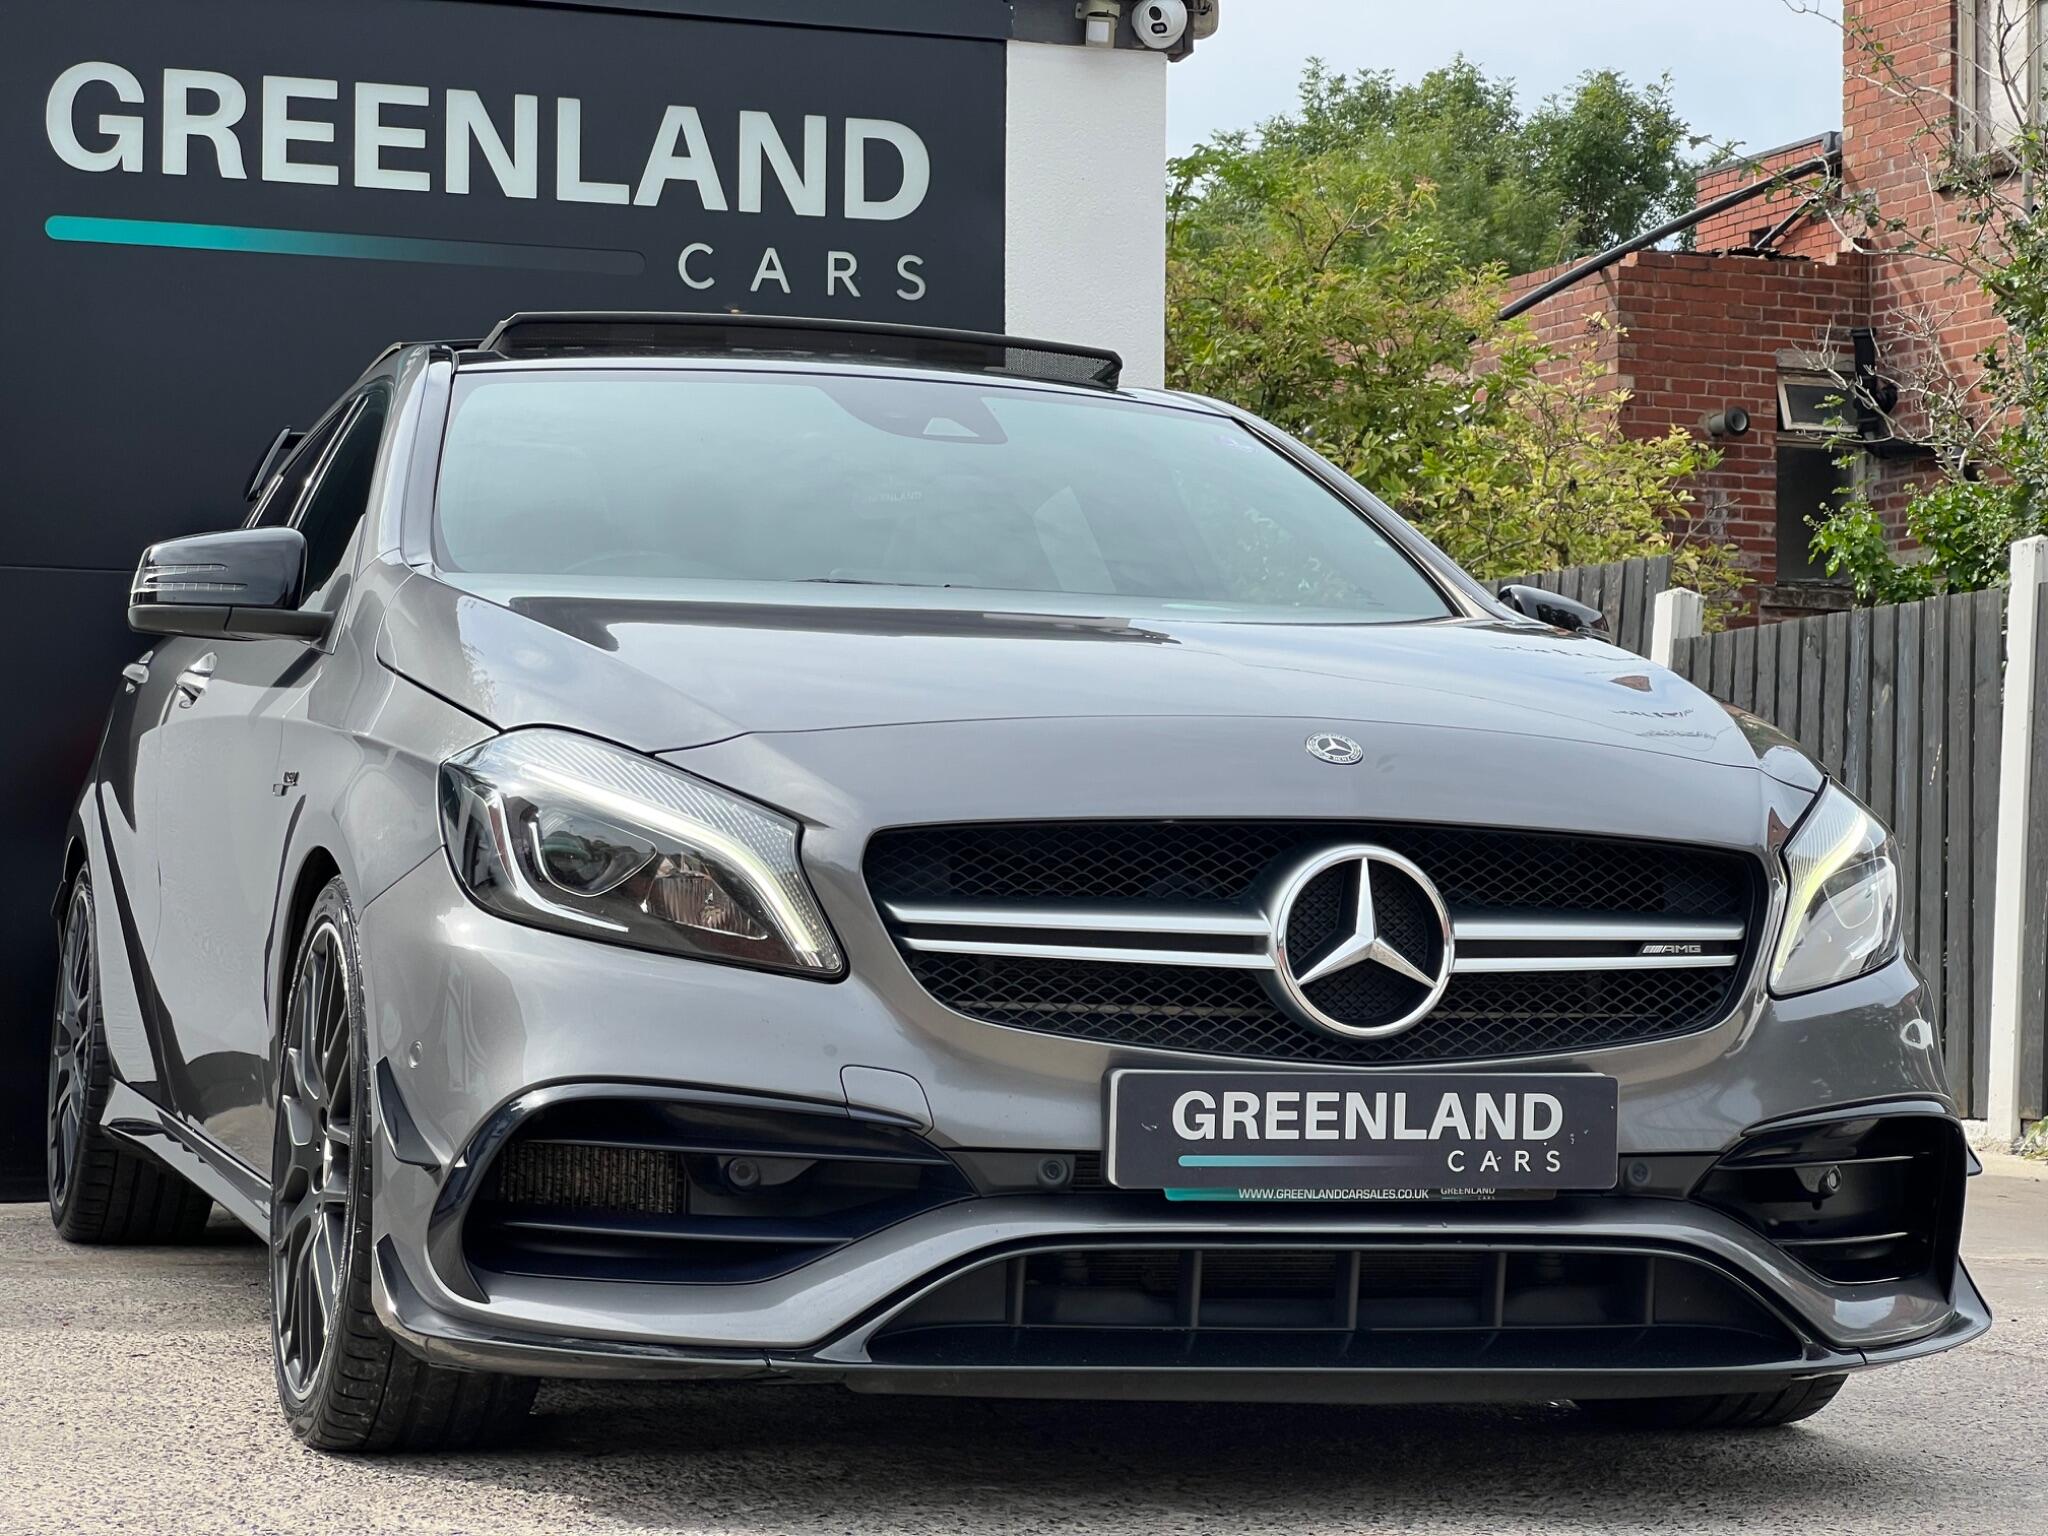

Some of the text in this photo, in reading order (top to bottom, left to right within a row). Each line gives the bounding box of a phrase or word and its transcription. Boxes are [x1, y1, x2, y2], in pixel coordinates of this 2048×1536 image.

[46, 61, 930, 221] GREENLAND
[678, 242, 927, 300] CARS
[1171, 1090, 1563, 1141] GREENLAND
[1447, 1150, 1561, 1173] CARS
[1238, 1188, 1429, 1200] WWW.GREENLANDCARSALES.CO.UK
[1440, 1187, 1496, 1195] GREENLAND
